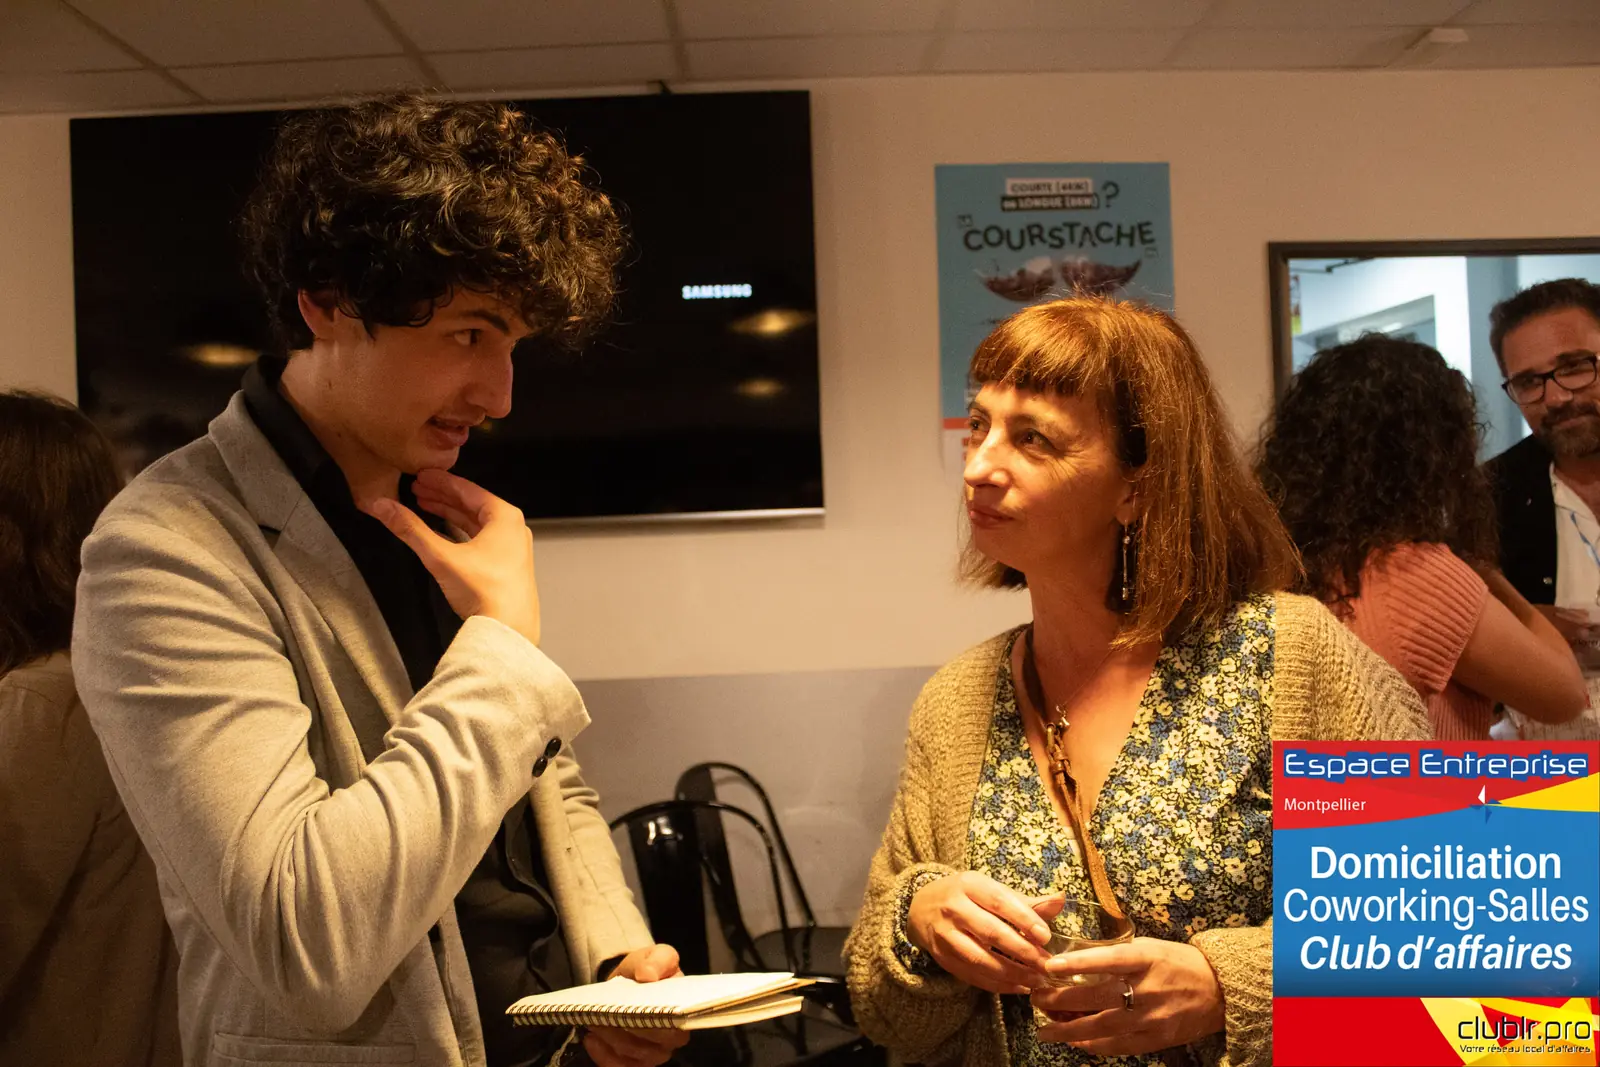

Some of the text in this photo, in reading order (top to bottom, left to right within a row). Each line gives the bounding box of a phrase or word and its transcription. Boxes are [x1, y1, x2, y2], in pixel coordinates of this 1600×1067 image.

[1011, 182, 1053, 193] COURTE
[1018, 196, 1062, 209] LONGUE
[964, 221, 1156, 251] COURSTACHE
[682, 284, 752, 299] SAMSUNG
